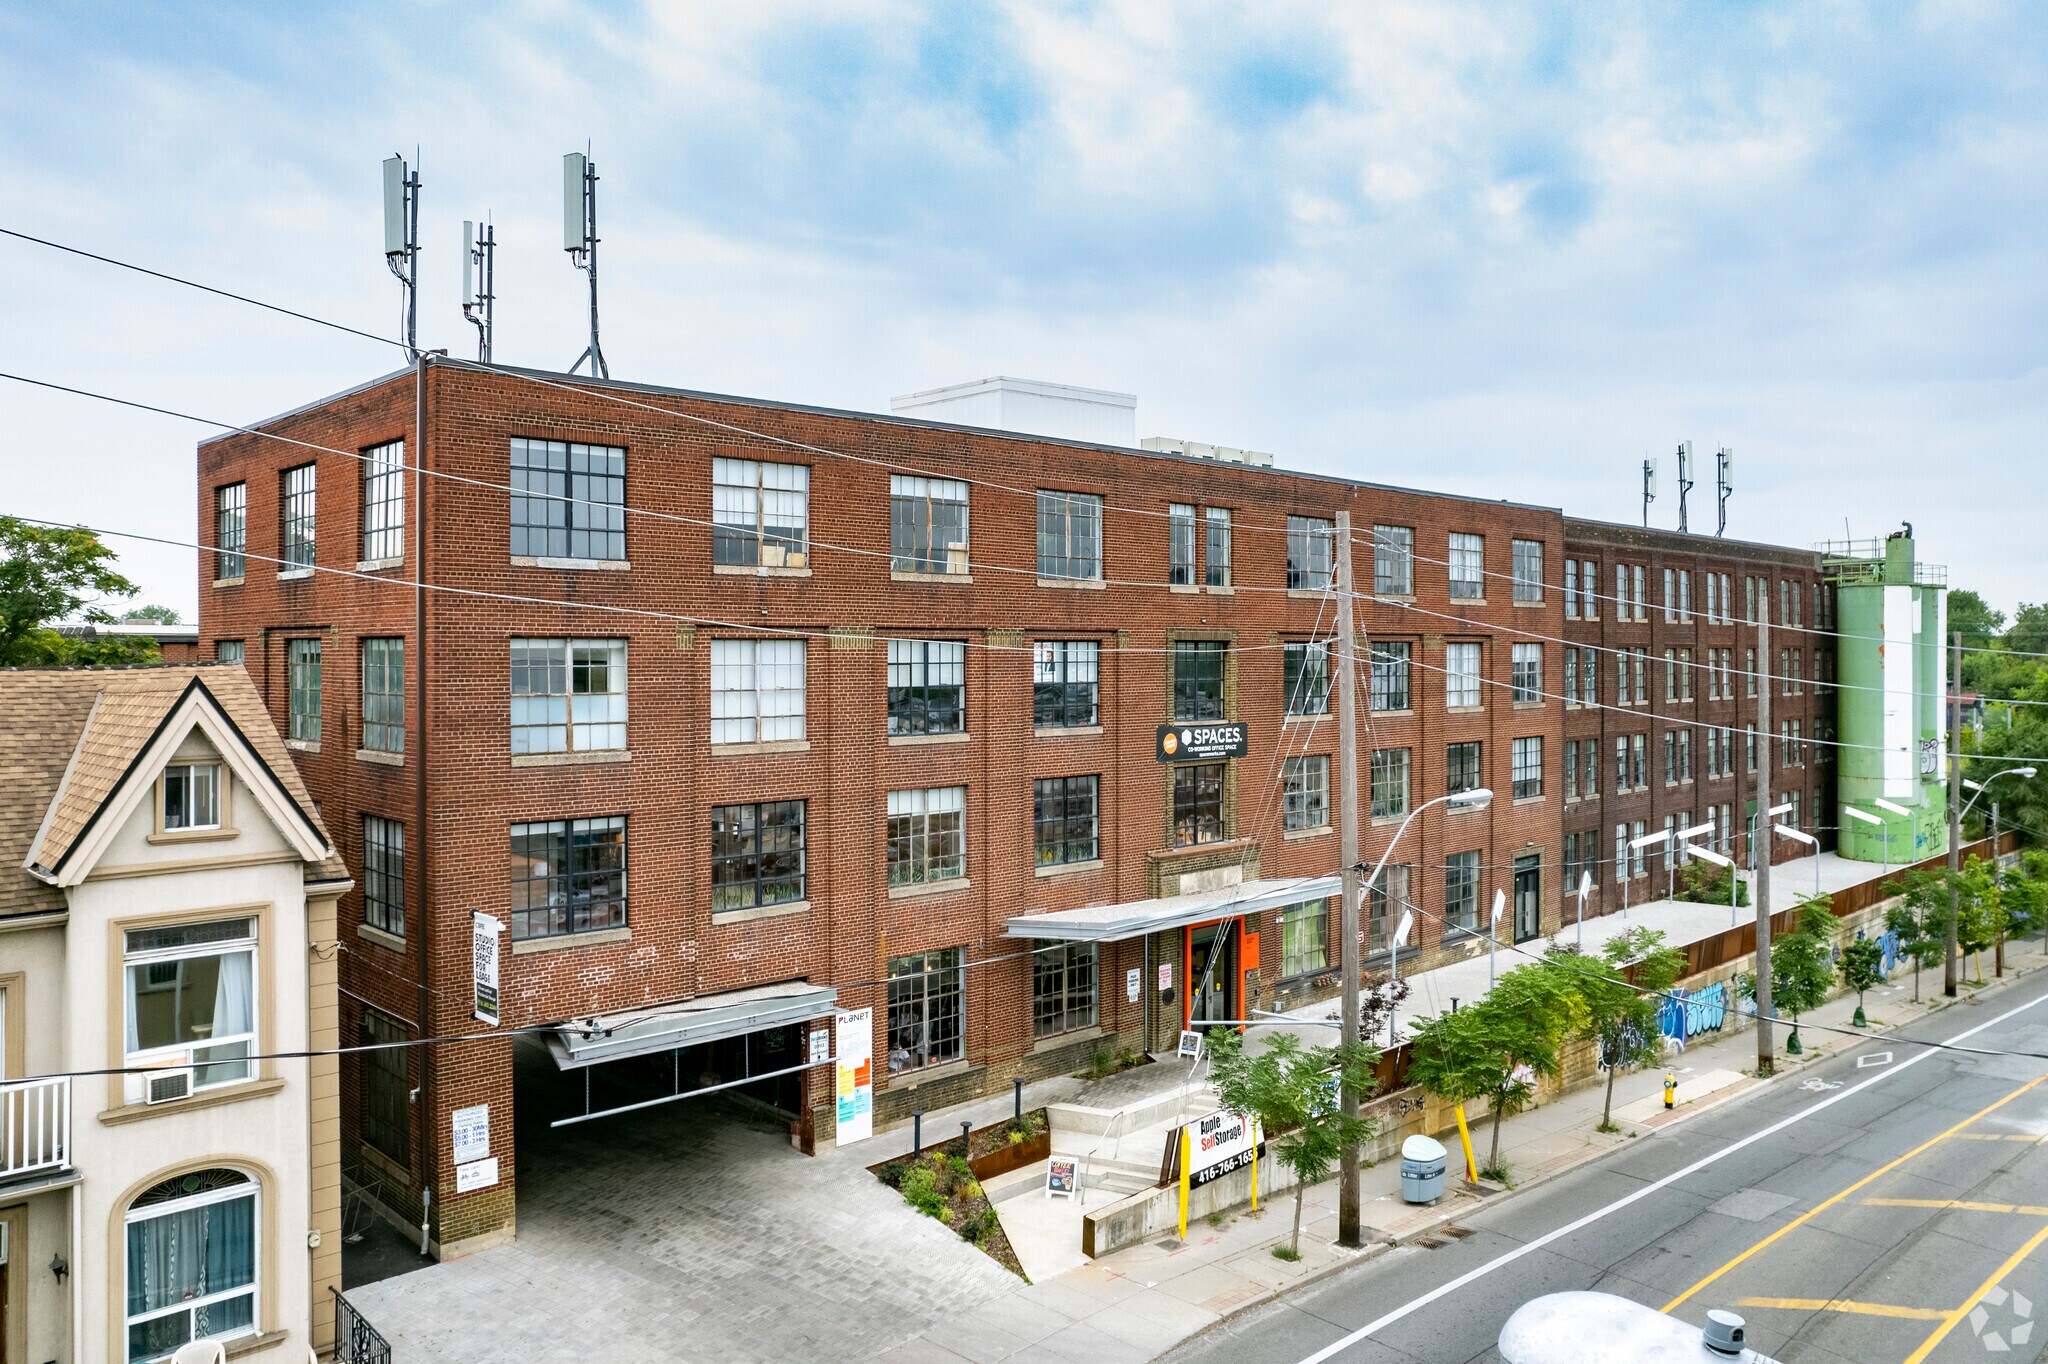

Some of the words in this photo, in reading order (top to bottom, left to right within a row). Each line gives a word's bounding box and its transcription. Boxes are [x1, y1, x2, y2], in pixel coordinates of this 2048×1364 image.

[475, 943, 493, 956] OFFICE
[475, 952, 491, 964] SPACE
[475, 961, 486, 971] FOR
[476, 970, 491, 983] LEASE
[1200, 1115, 1221, 1135] Apple
[1201, 1124, 1242, 1152] SelfStorage
